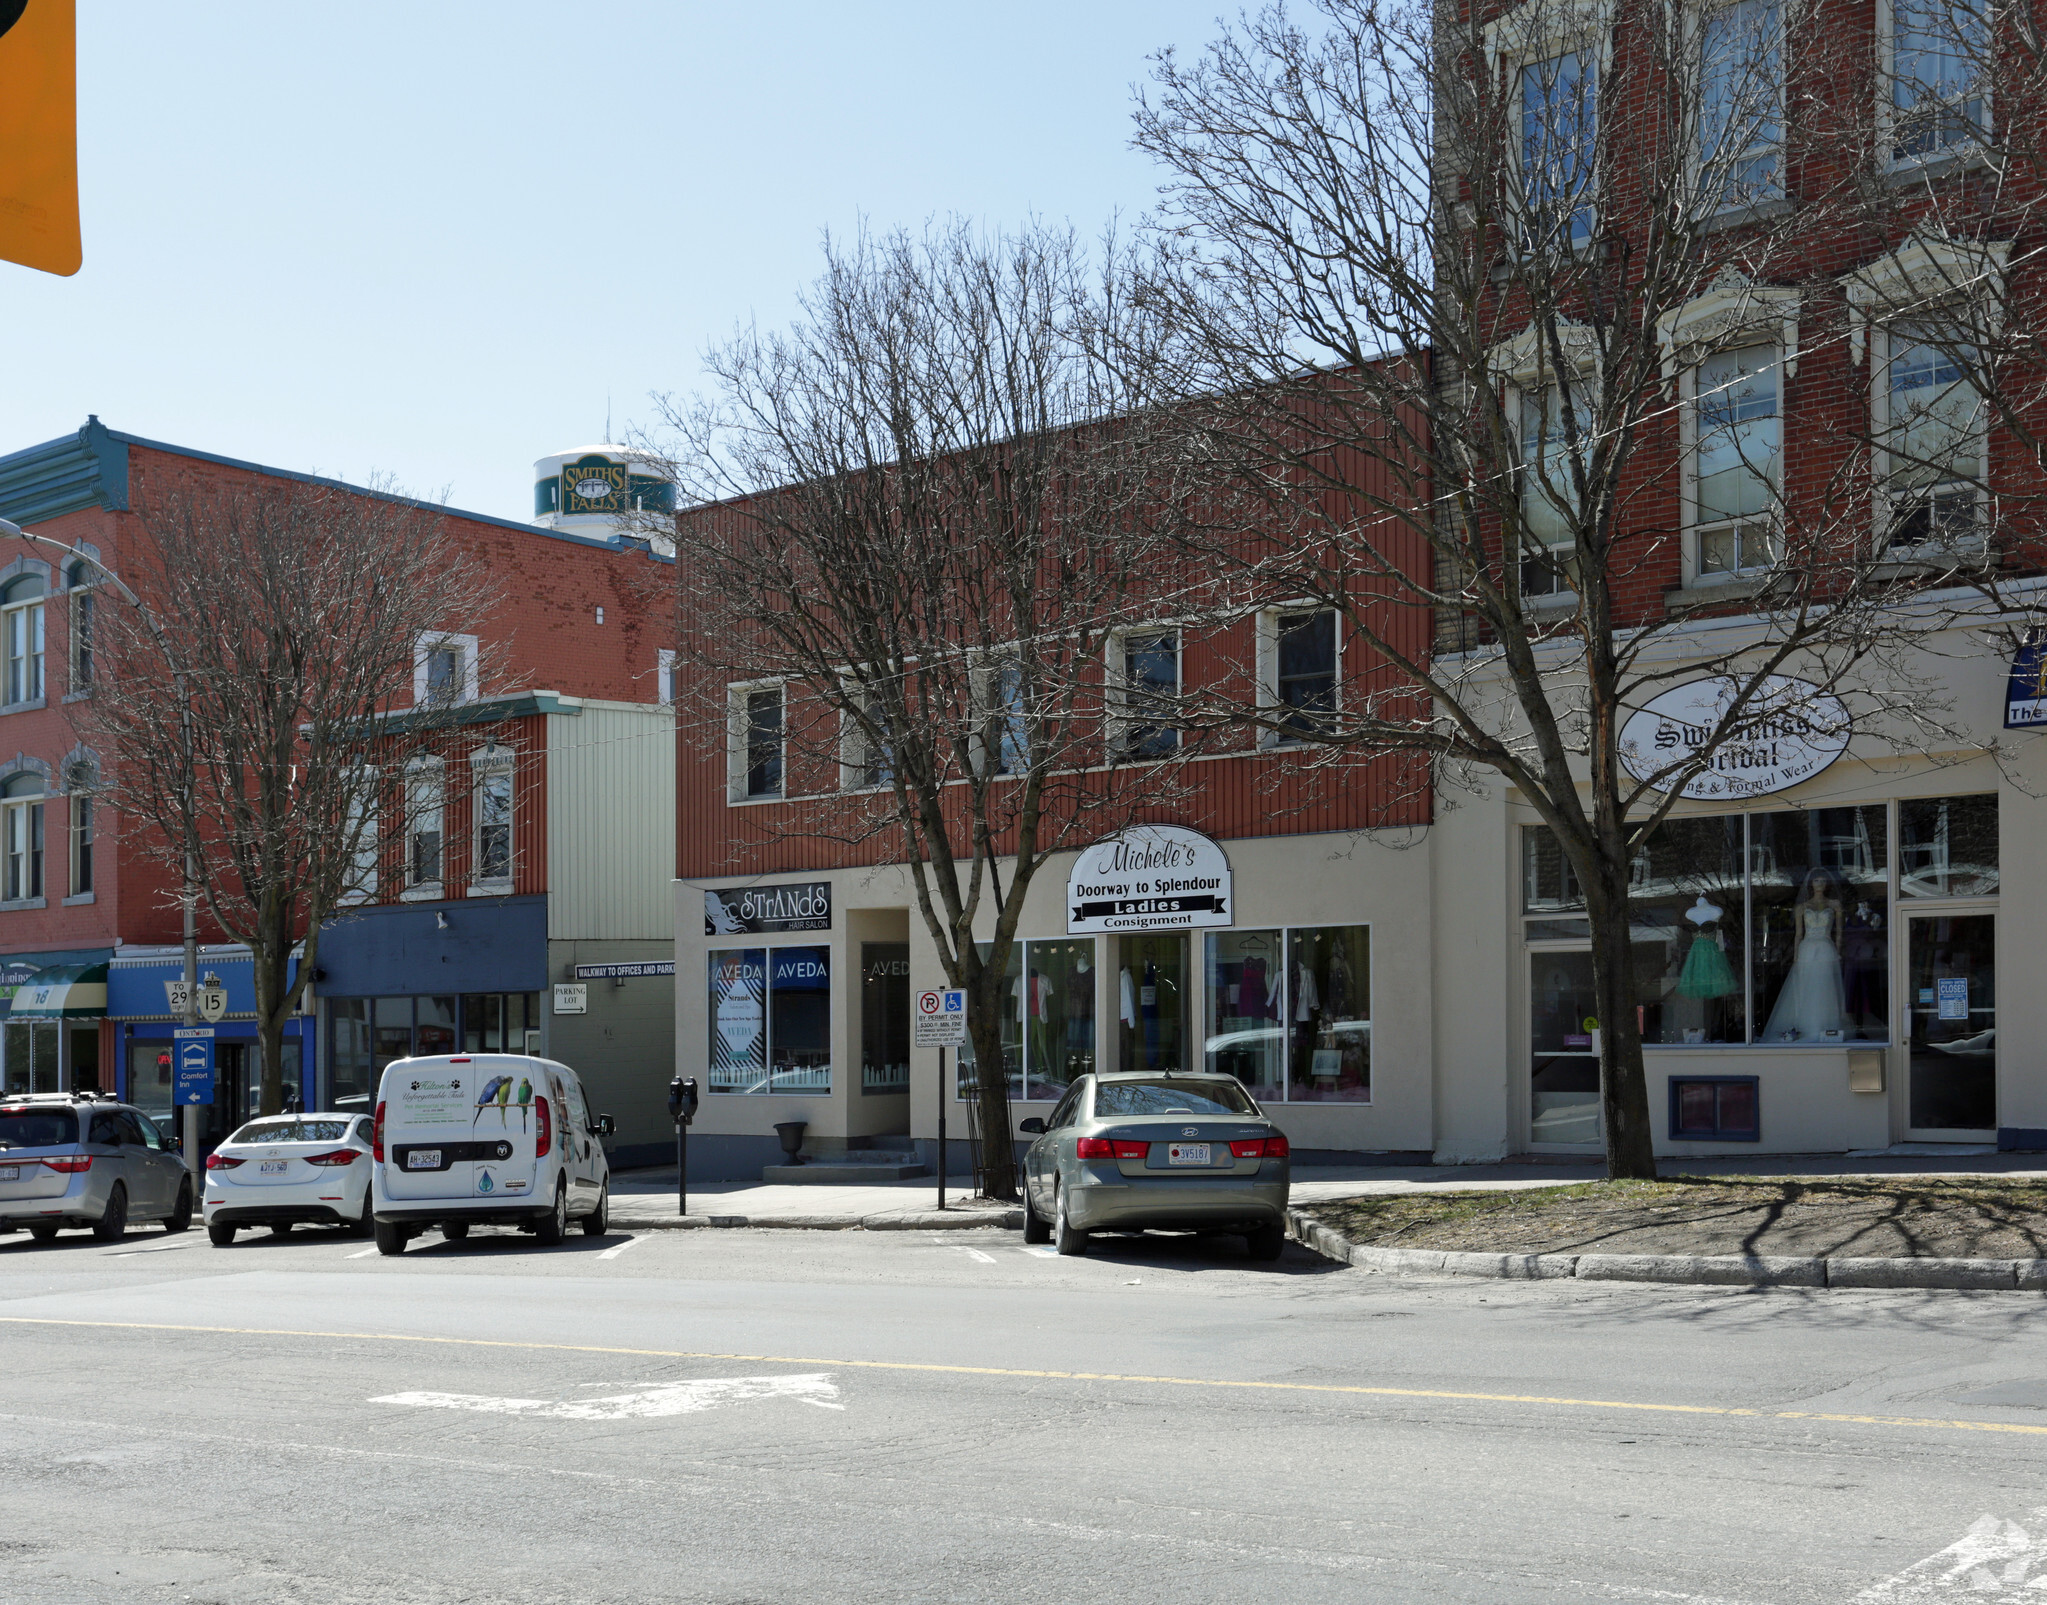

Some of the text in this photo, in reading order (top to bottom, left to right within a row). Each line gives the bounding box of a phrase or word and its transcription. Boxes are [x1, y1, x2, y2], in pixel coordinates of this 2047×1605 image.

[565, 466, 624, 491] SMITHS
[570, 492, 619, 512] FALLS
[2010, 706, 2042, 720] The
[1710, 781, 1721, 794] &
[1781, 761, 1814, 780] Wear
[1098, 840, 1195, 874] Michele's
[1077, 876, 1221, 898] Doorway to Splendour
[1114, 900, 1180, 914] Ladies
[788, 920, 828, 930] HAIR SALON
[1104, 914, 1192, 928] Consignment
[578, 967, 606, 978] WALKWAY
[607, 966, 616, 976] TO
[617, 965, 641, 976] OFFICES
[643, 965, 655, 975] AND
[715, 963, 762, 980] AVEDA
[777, 962, 827, 979] AVEDA
[555, 987, 586, 995] PARKING
[1940, 985, 1966, 993] CLOSED
[35, 989, 50, 1004] 18
[172, 992, 187, 1004] 29
[205, 994, 221, 1010] 15
[728, 993, 751, 1001] Strands
[181, 1072, 208, 1080] Comfort
[1180, 1148, 1208, 1159] 3V5187
